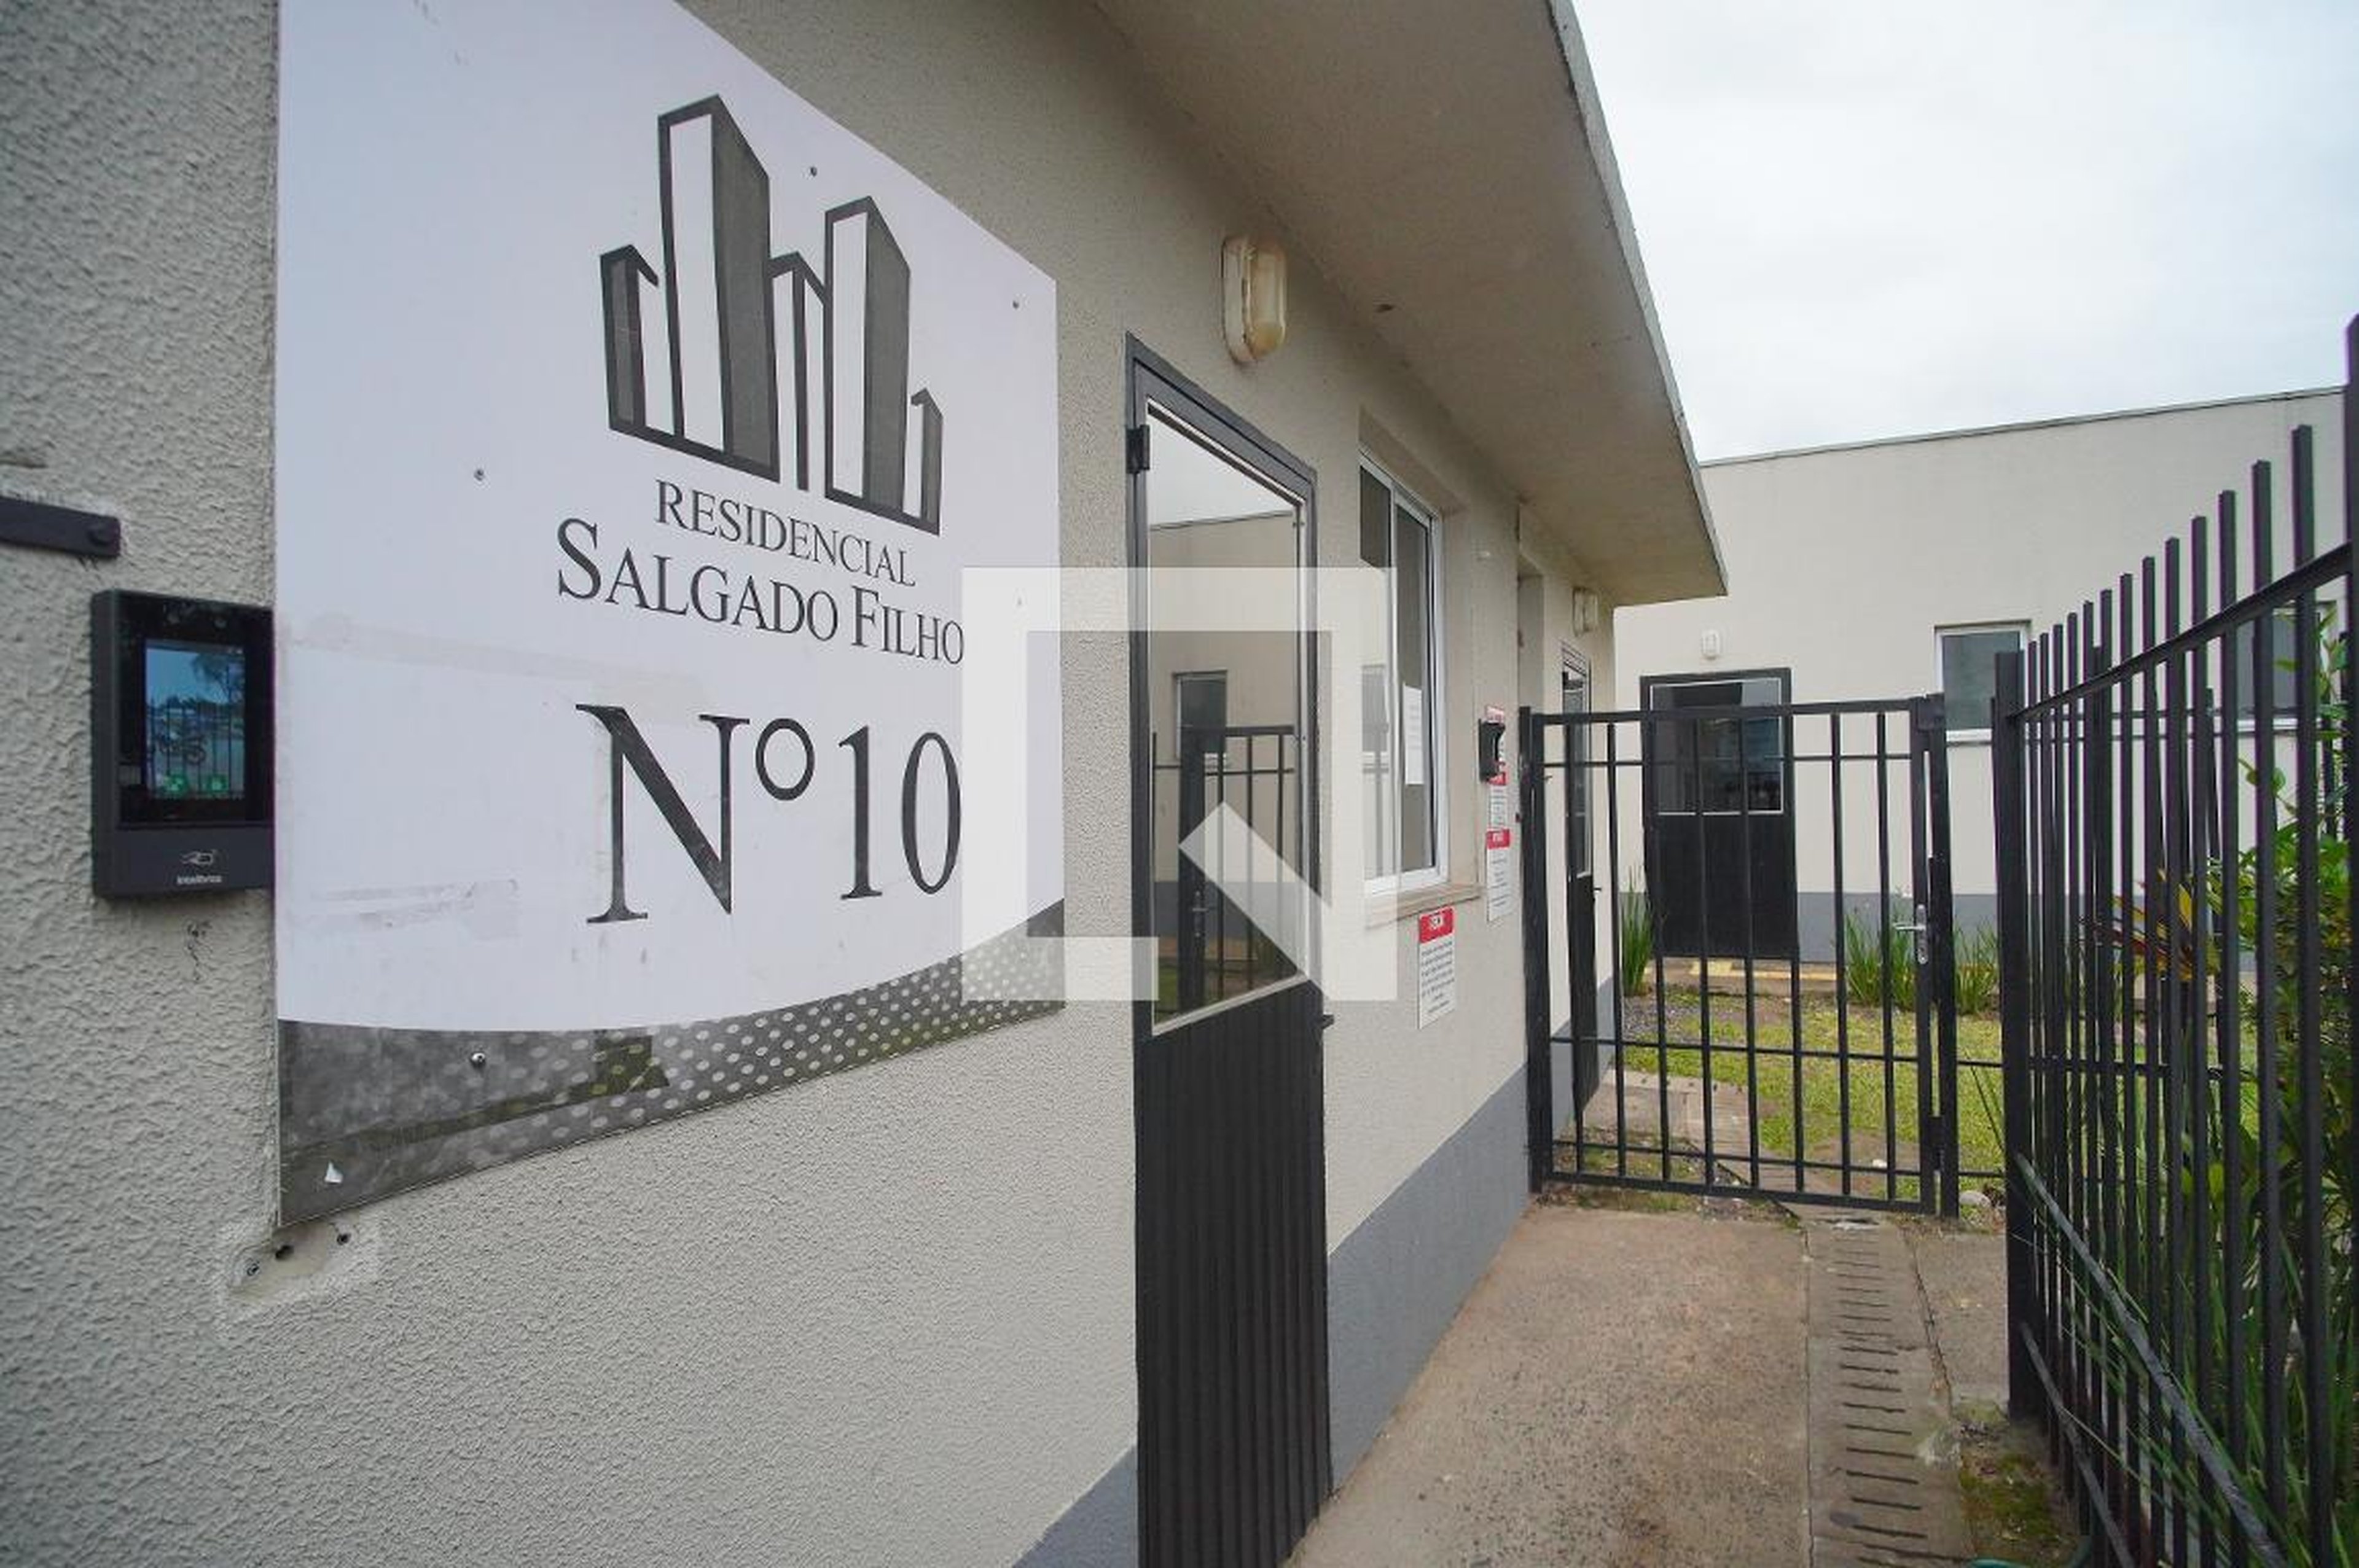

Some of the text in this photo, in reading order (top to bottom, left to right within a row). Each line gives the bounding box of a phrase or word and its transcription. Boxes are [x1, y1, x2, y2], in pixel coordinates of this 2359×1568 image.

[557, 518, 964, 665] SALGADO FILHO
[655, 479, 915, 587] RESIDENCIAL
